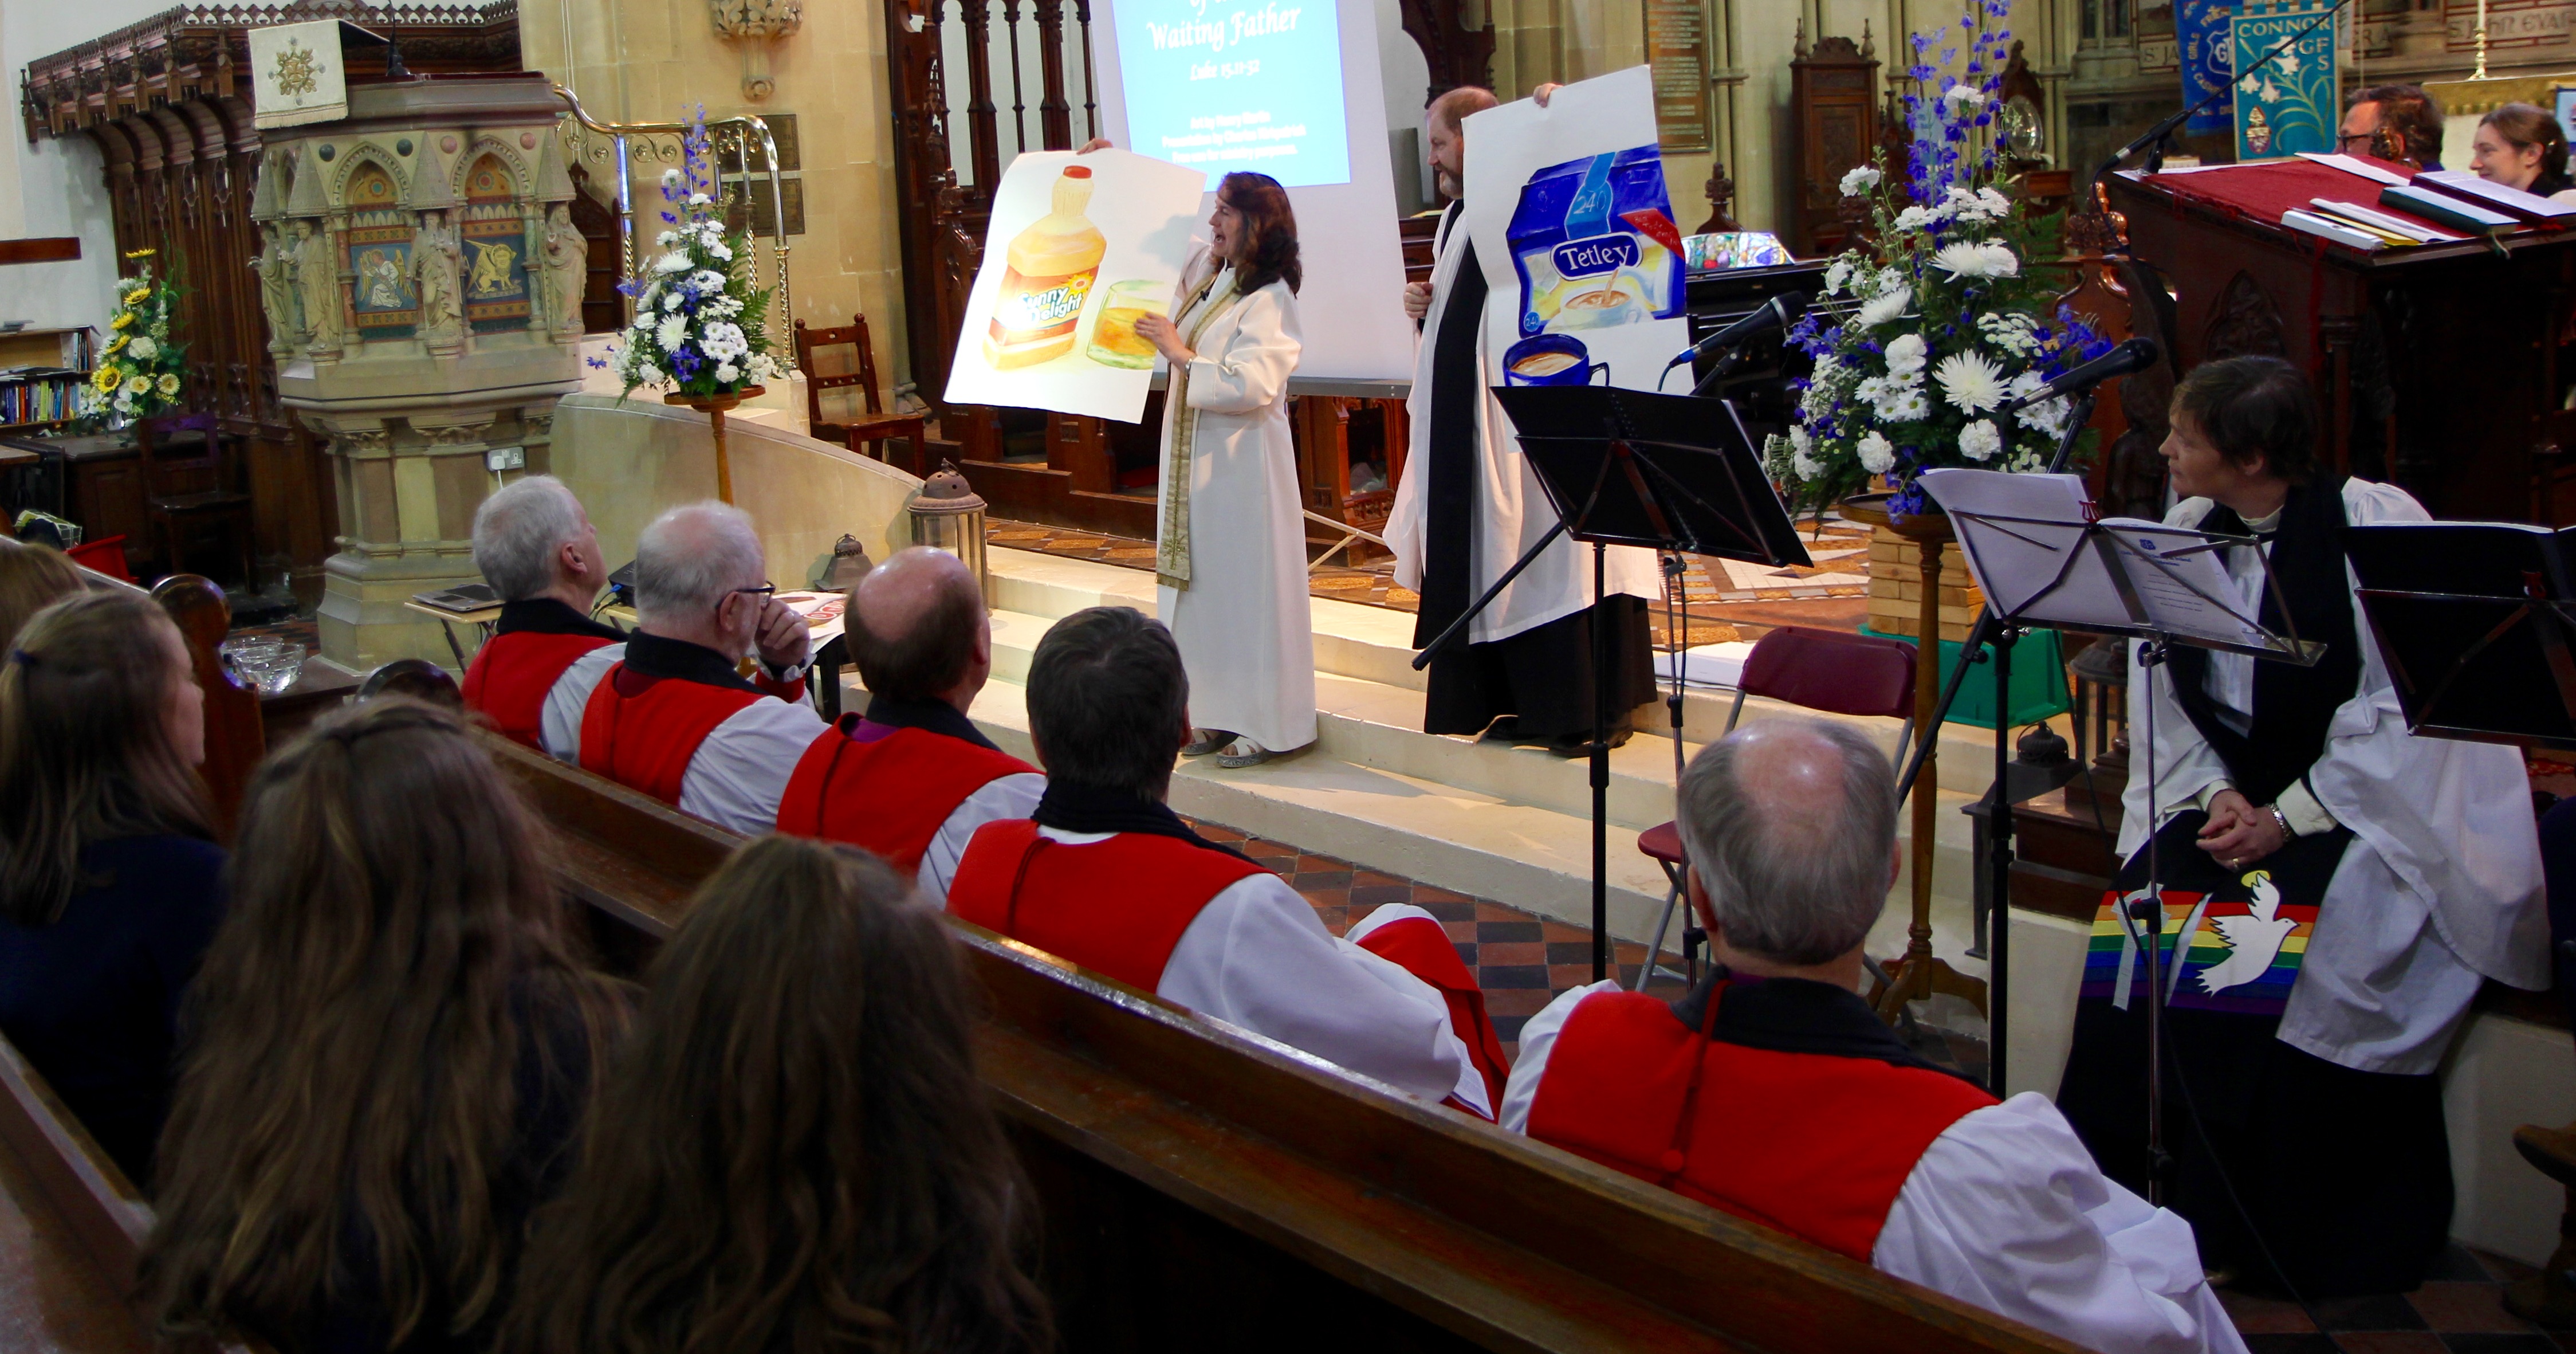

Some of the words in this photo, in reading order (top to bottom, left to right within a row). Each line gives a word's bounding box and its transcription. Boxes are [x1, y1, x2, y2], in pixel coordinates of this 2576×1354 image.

[1146, 18, 1225, 52] Waiting
[1229, 2, 1301, 46] Father
[2238, 17, 2331, 37] CONNOR
[2298, 37, 2330, 55] GF
[1190, 60, 1217, 81] Luke
[2317, 55, 2330, 71] S
[1573, 190, 1607, 214] 240
[1559, 244, 1632, 270] Tetley
[1018, 287, 1070, 309] Sunny
[1028, 292, 1083, 324] Delight
